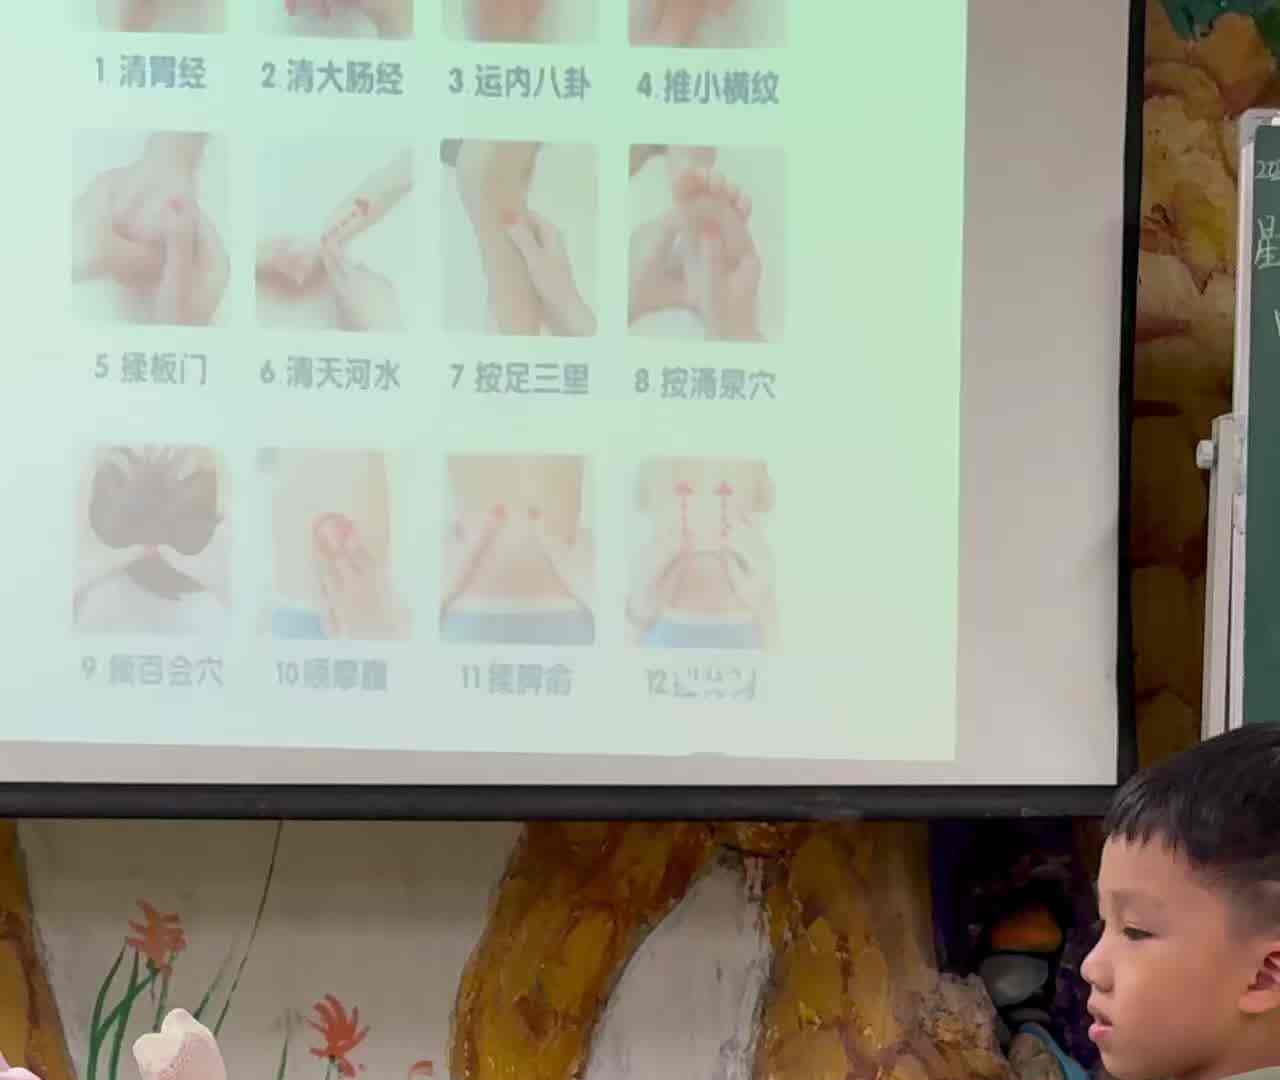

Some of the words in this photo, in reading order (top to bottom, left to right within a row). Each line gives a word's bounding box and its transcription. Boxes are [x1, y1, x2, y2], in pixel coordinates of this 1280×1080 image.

[119, 54, 208, 89] 清胃经
[287, 59, 405, 95] 清大肠经
[474, 65, 592, 100] 运内八卦
[663, 69, 780, 106] 推小横纹
[287, 355, 401, 391] 清天河水
[474, 361, 590, 395] 按足三里
